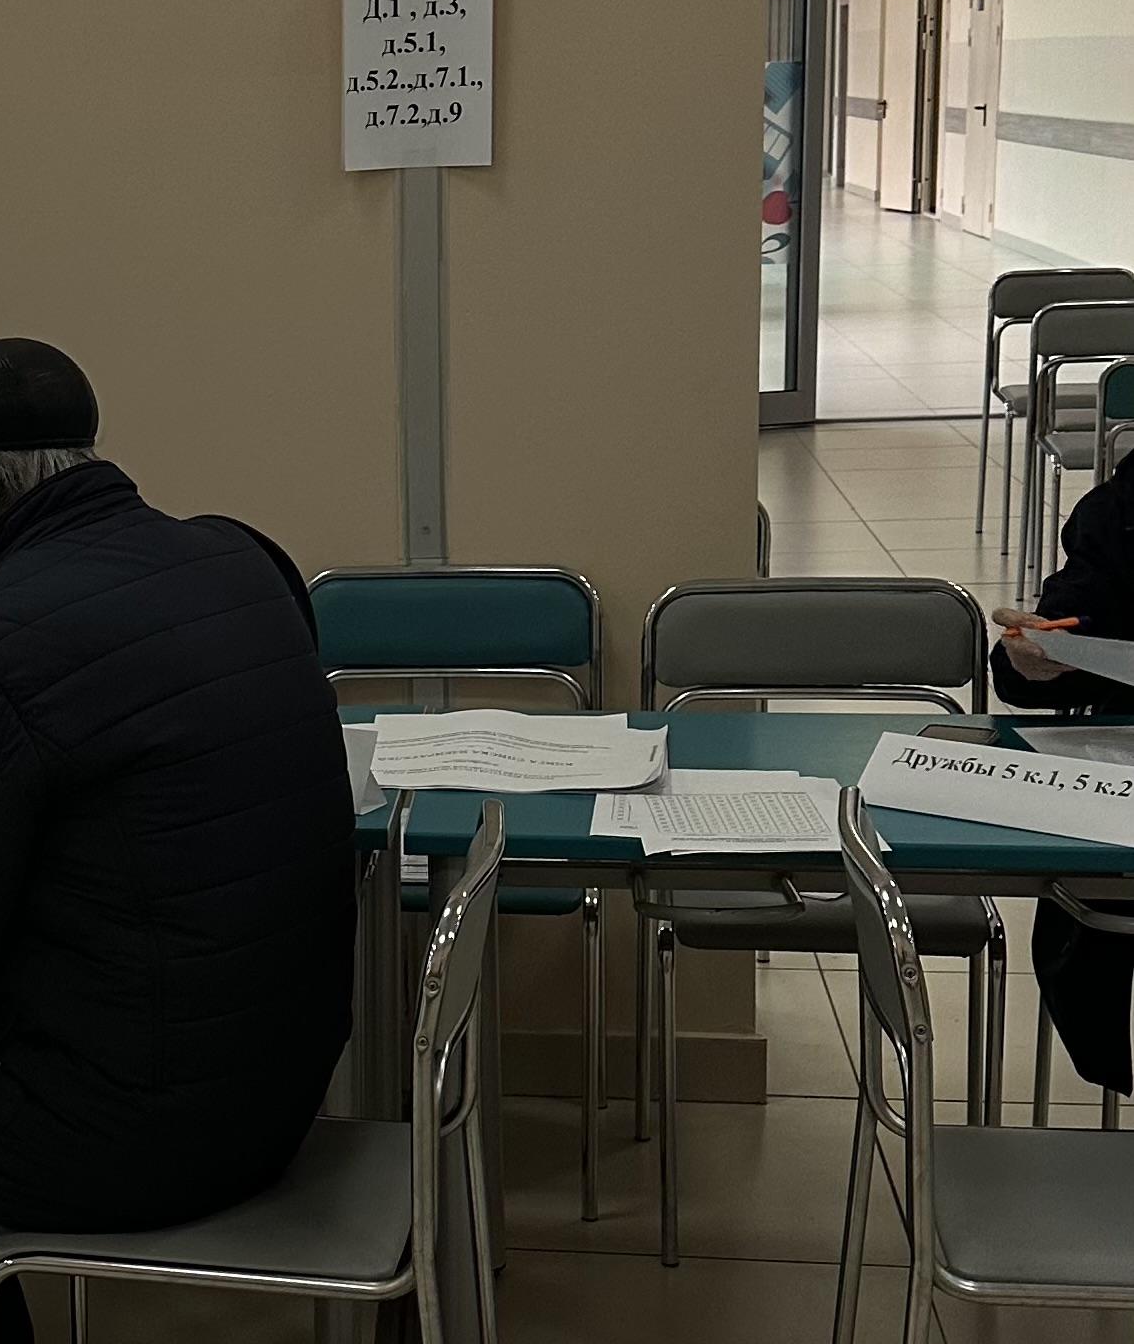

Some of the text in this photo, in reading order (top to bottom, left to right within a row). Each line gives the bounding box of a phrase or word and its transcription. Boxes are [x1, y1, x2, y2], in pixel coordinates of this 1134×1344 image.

[381, 31, 446, 57] д.5.1,
[365, 102, 463, 130] д.7.2,д.9
[891, 747, 1134, 798] Дружбы 5 к.1, 5 к.2
